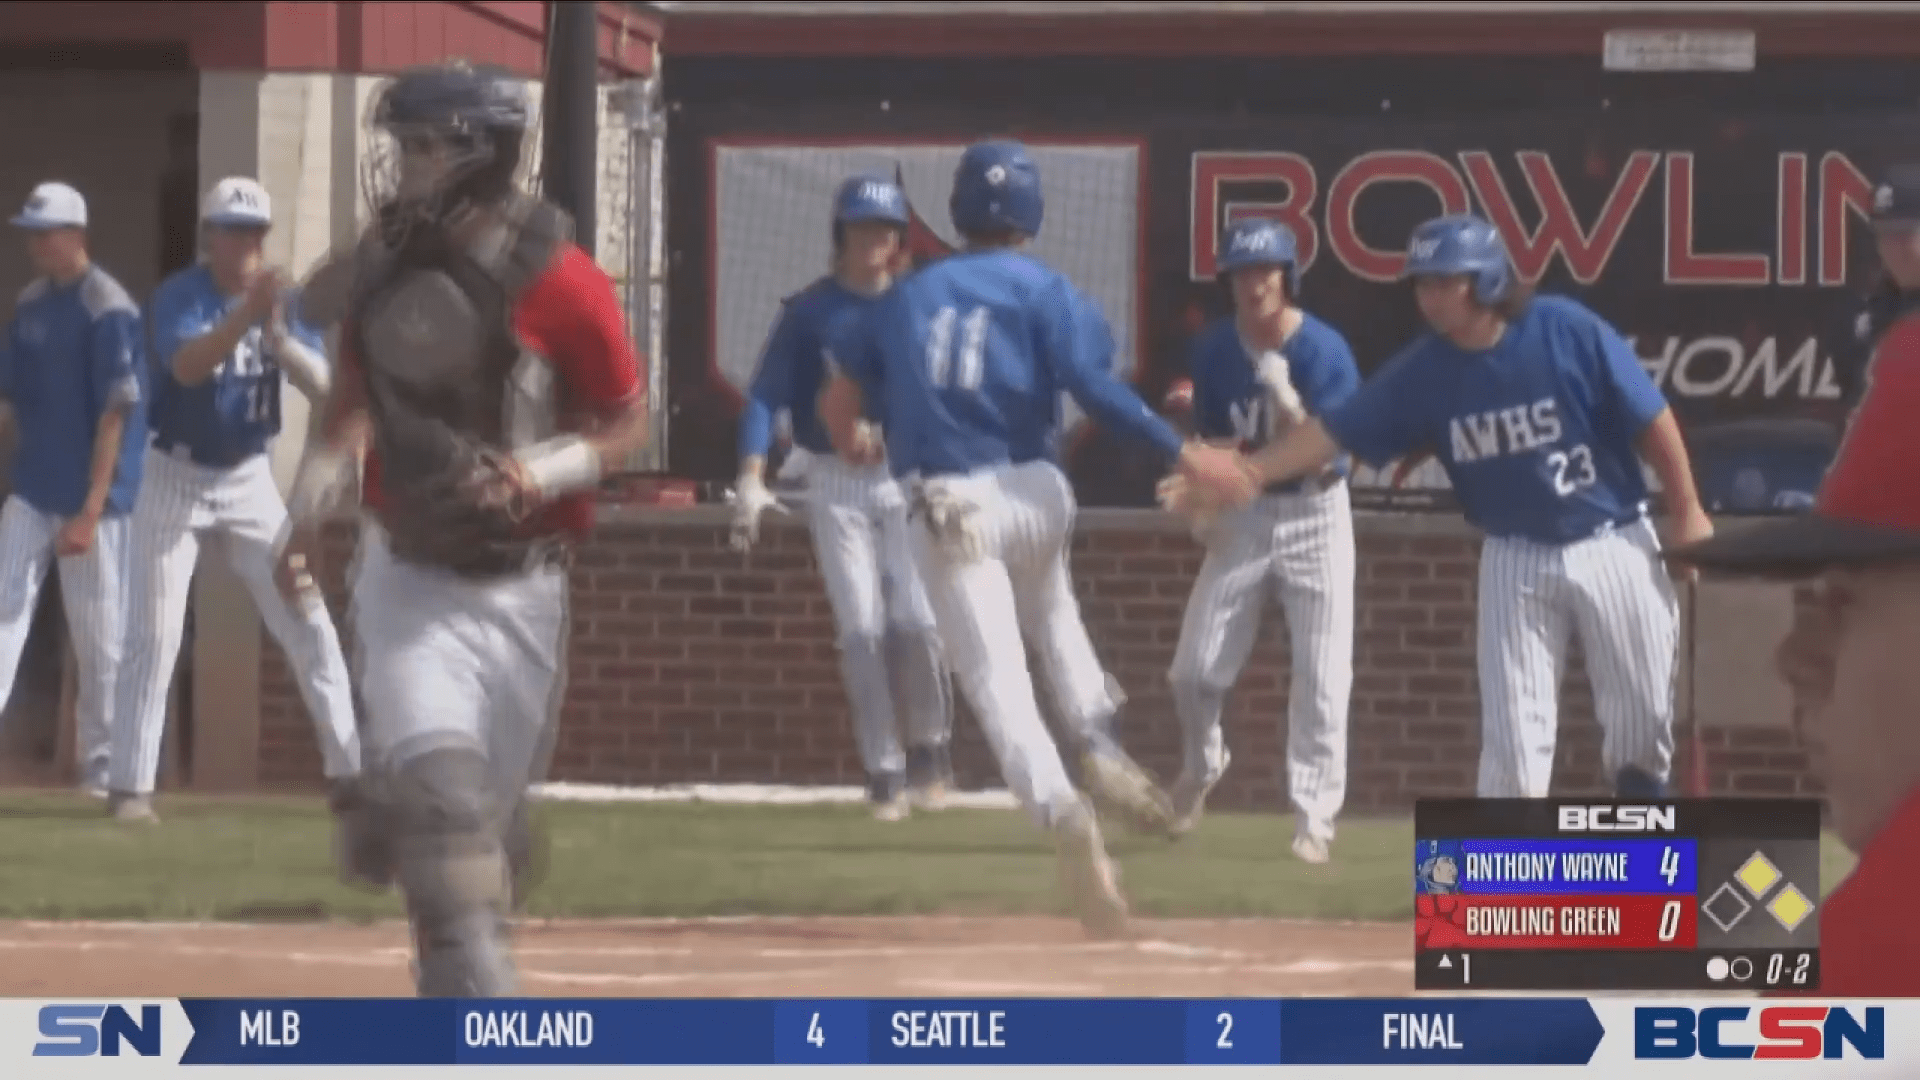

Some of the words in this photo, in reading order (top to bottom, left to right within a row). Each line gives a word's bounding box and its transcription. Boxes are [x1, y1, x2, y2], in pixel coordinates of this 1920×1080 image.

[926, 304, 991, 391] 11
[1450, 397, 1563, 464] AWHS
[1547, 443, 1597, 496] 23
